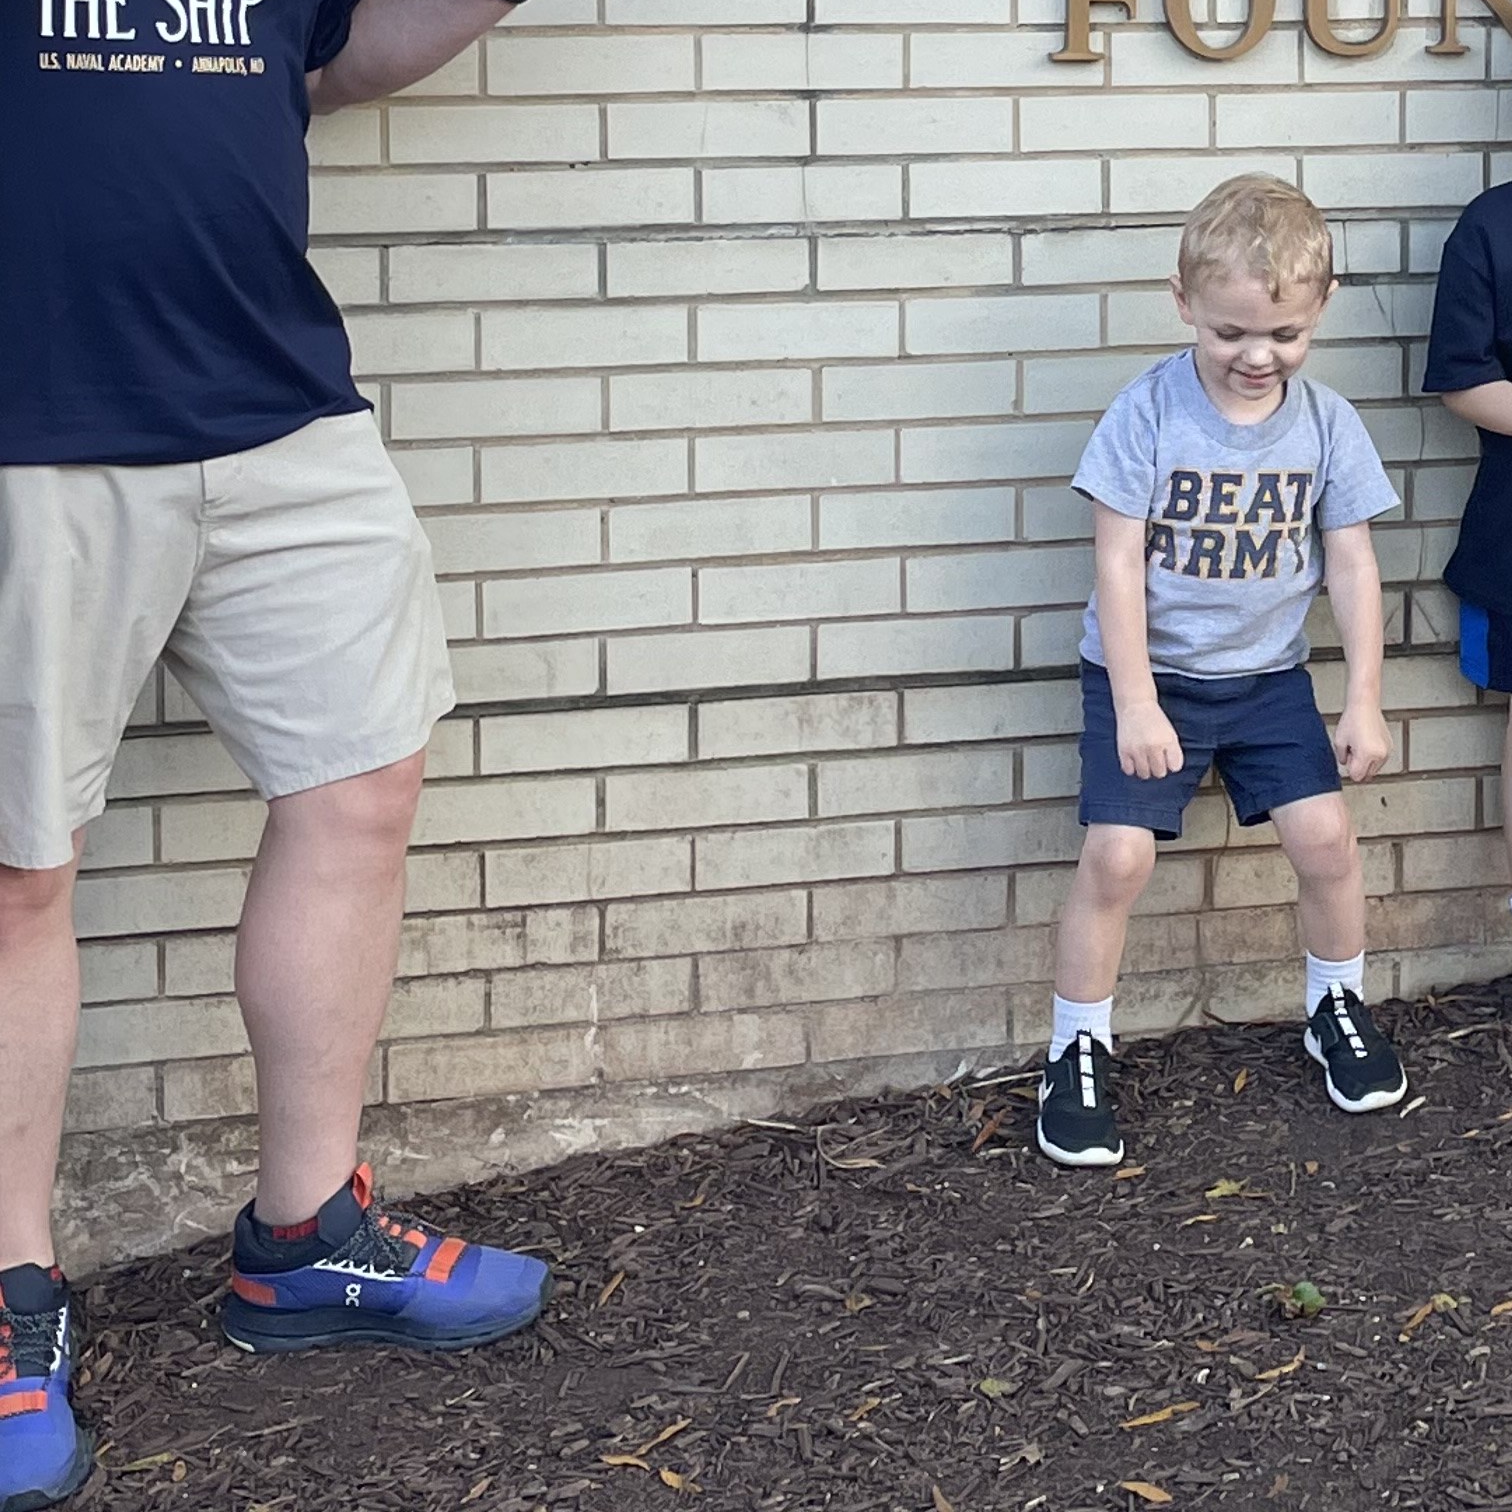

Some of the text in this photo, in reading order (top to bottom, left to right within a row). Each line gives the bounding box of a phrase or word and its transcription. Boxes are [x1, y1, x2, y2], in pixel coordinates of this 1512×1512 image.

[38, 52, 62, 70] U.S.
[65, 52, 105, 72] NAVAL
[108, 54, 166, 73] ACADEMY
[1160, 468, 1315, 524] BEAT
